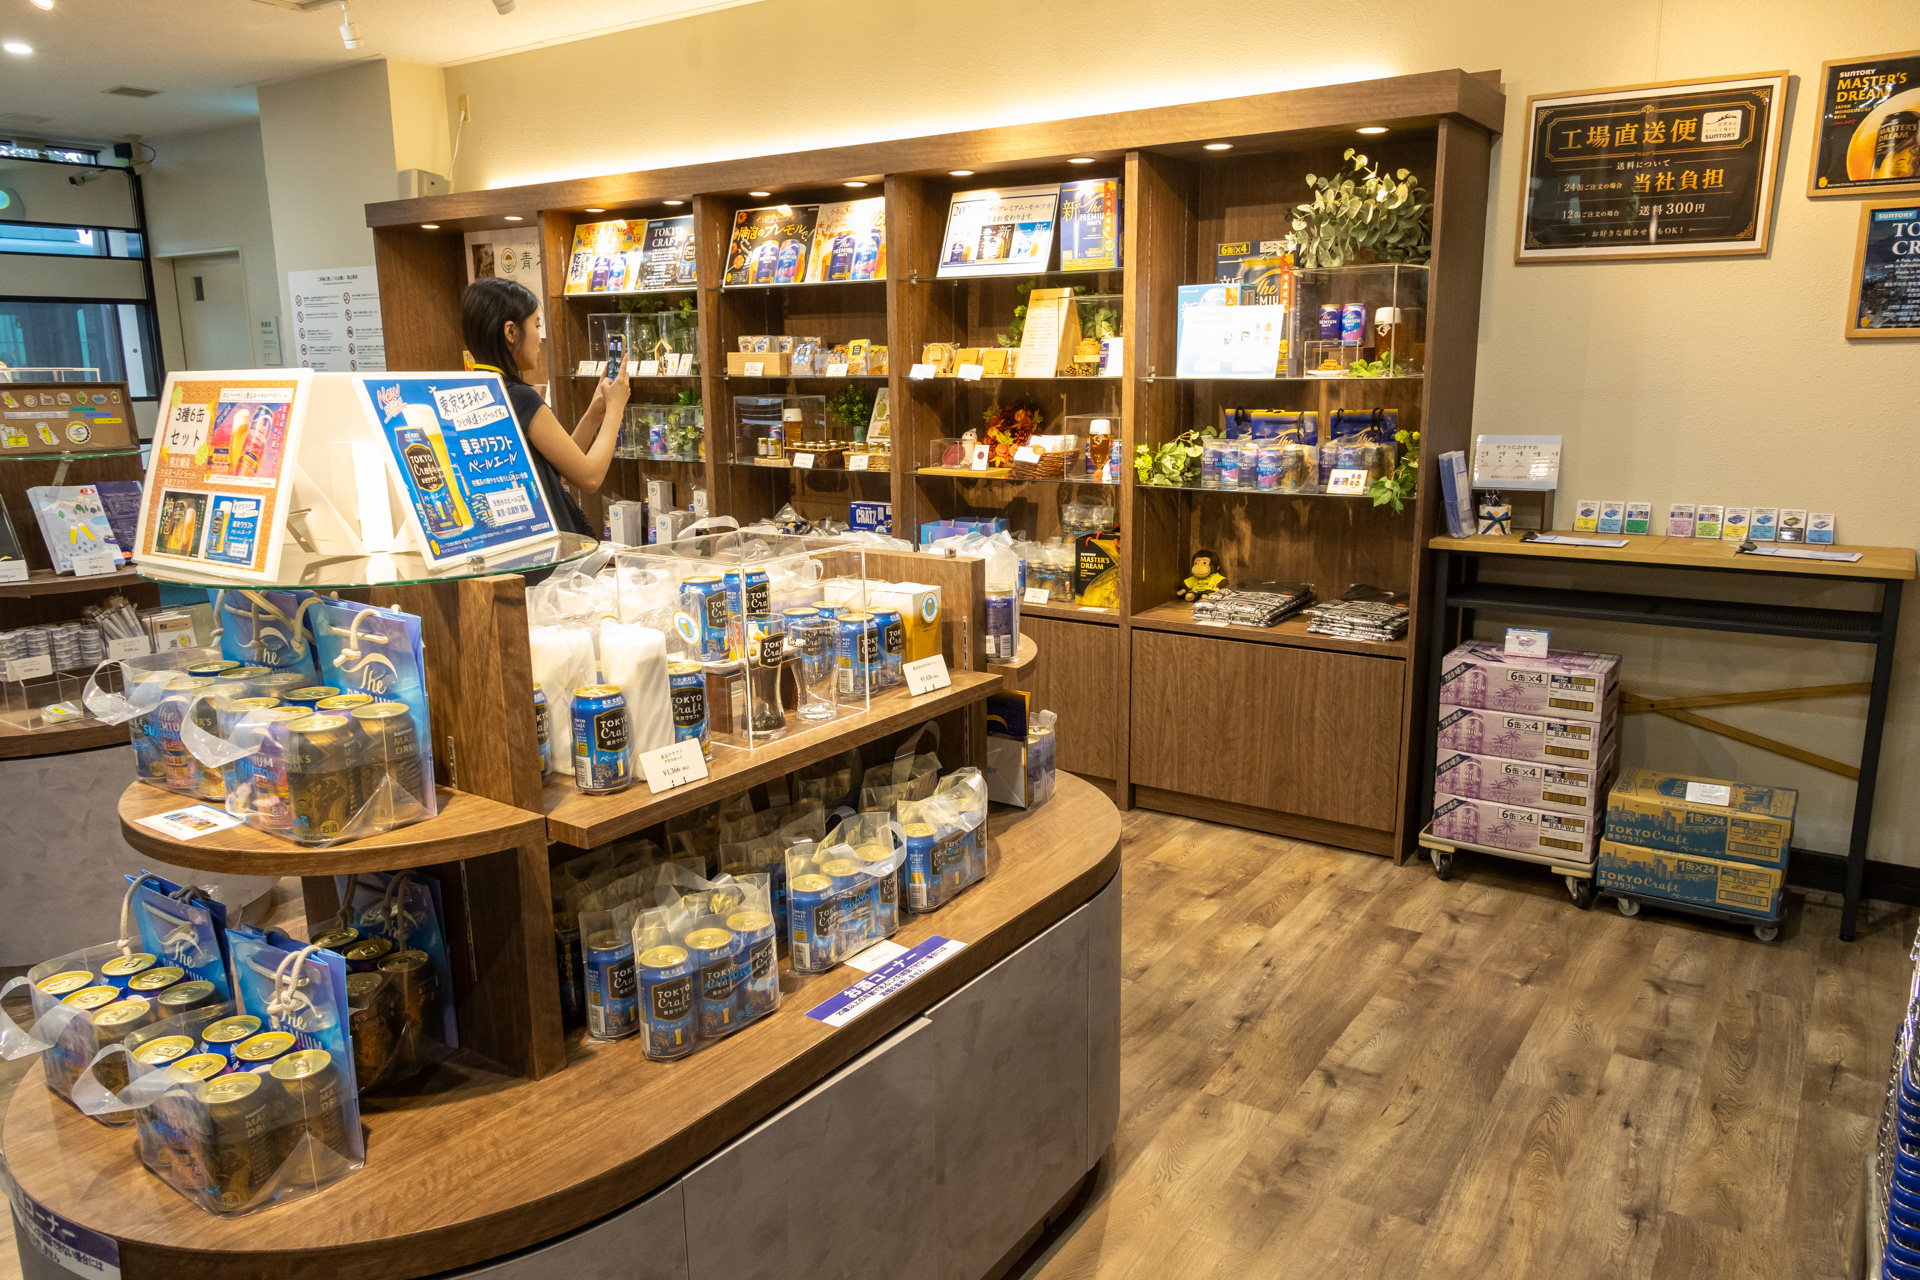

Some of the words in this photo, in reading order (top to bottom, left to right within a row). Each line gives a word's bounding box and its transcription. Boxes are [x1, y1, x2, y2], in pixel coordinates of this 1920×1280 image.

[1839, 69, 1877, 78] SUNTORY
[1836, 72, 1908, 91] MASTER'S
[1836, 87, 1891, 103] DREAM
[1558, 117, 1699, 151] 工場直送便
[1880, 123, 1918, 134] MASTER'S
[1704, 132, 1736, 140] SUNTORY
[1879, 131, 1909, 142] DREAM
[1616, 159, 1671, 171] 送料について
[1632, 168, 1725, 193] 当社負担
[1563, 182, 1623, 193] 24缶ご注文の場合
[1561, 209, 1620, 220] 12缶ご注文の場合
[1257, 277, 1279, 295] The
[376, 383, 401, 409] New
[439, 388, 488, 417] 東京生まれの
[175, 407, 205, 424] 3種6缶
[170, 428, 200, 447] セット
[459, 435, 513, 456] 東京クラフト
[409, 454, 433, 464] TOKYO
[468, 451, 518, 474] ペールエール
[413, 463, 437, 476] Craft
[530, 521, 551, 532] SUNTORY
[1080, 556, 1110, 564] MASTER'S
[1080, 562, 1104, 570] DREAM
[357, 664, 387, 694] The
[1559, 683, 1587, 691] BAPW6
[1555, 731, 1582, 740] BAPW6
[661, 749, 683, 760] 東京クラフト
[664, 755, 683, 764] グラスセット
[662, 767, 681, 777] ¥1,366
[1552, 777, 1580, 786] BAPW6
[1550, 822, 1577, 832] BAPW6
[1607, 833, 1645, 844] 東京クラフト
[1608, 824, 1652, 838] TOKYO
[1652, 829, 1690, 844] Craft
[1600, 870, 1642, 885] TOKYO
[1643, 877, 1680, 892] Craft
[1600, 879, 1637, 890] 東京クラフト
[173, 942, 195, 968] The
[844, 953, 917, 998] お酒コーナー
[656, 983, 691, 999] TOKYO
[658, 992, 692, 1009] Craft
